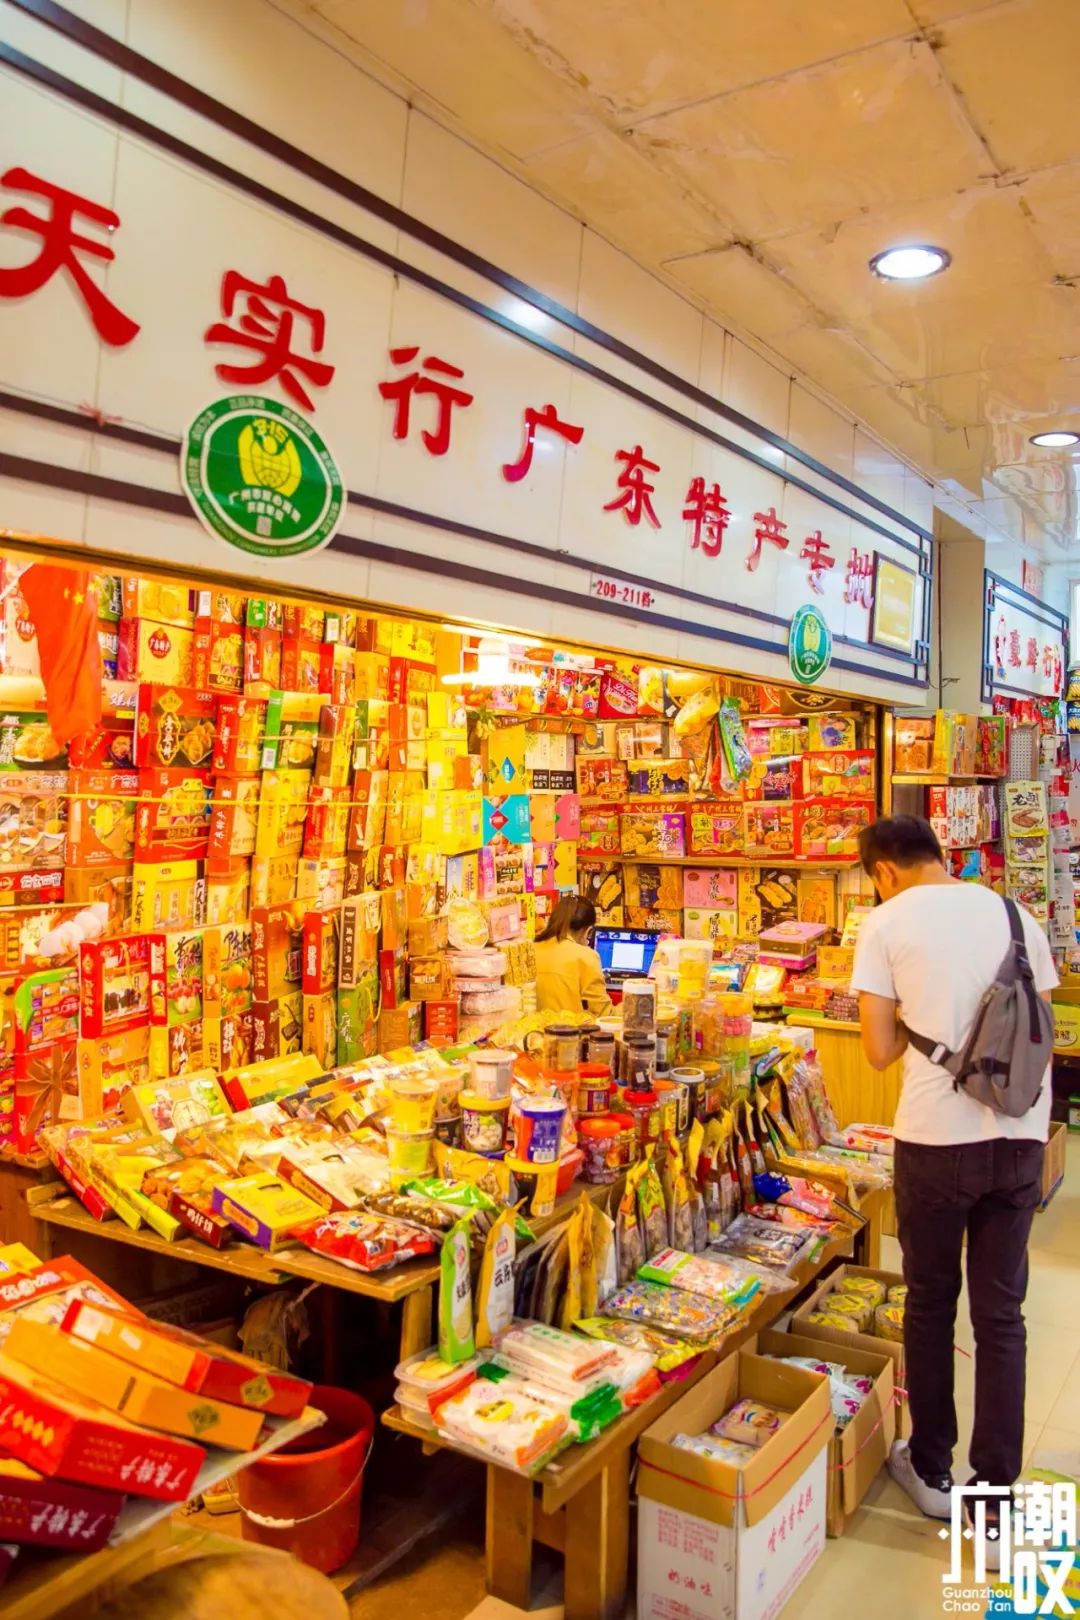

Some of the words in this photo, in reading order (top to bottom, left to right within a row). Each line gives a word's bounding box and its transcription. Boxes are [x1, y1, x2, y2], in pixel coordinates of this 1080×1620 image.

[120, 1455, 188, 1491] 广东特产
[31, 1503, 107, 1539] 广东特产
